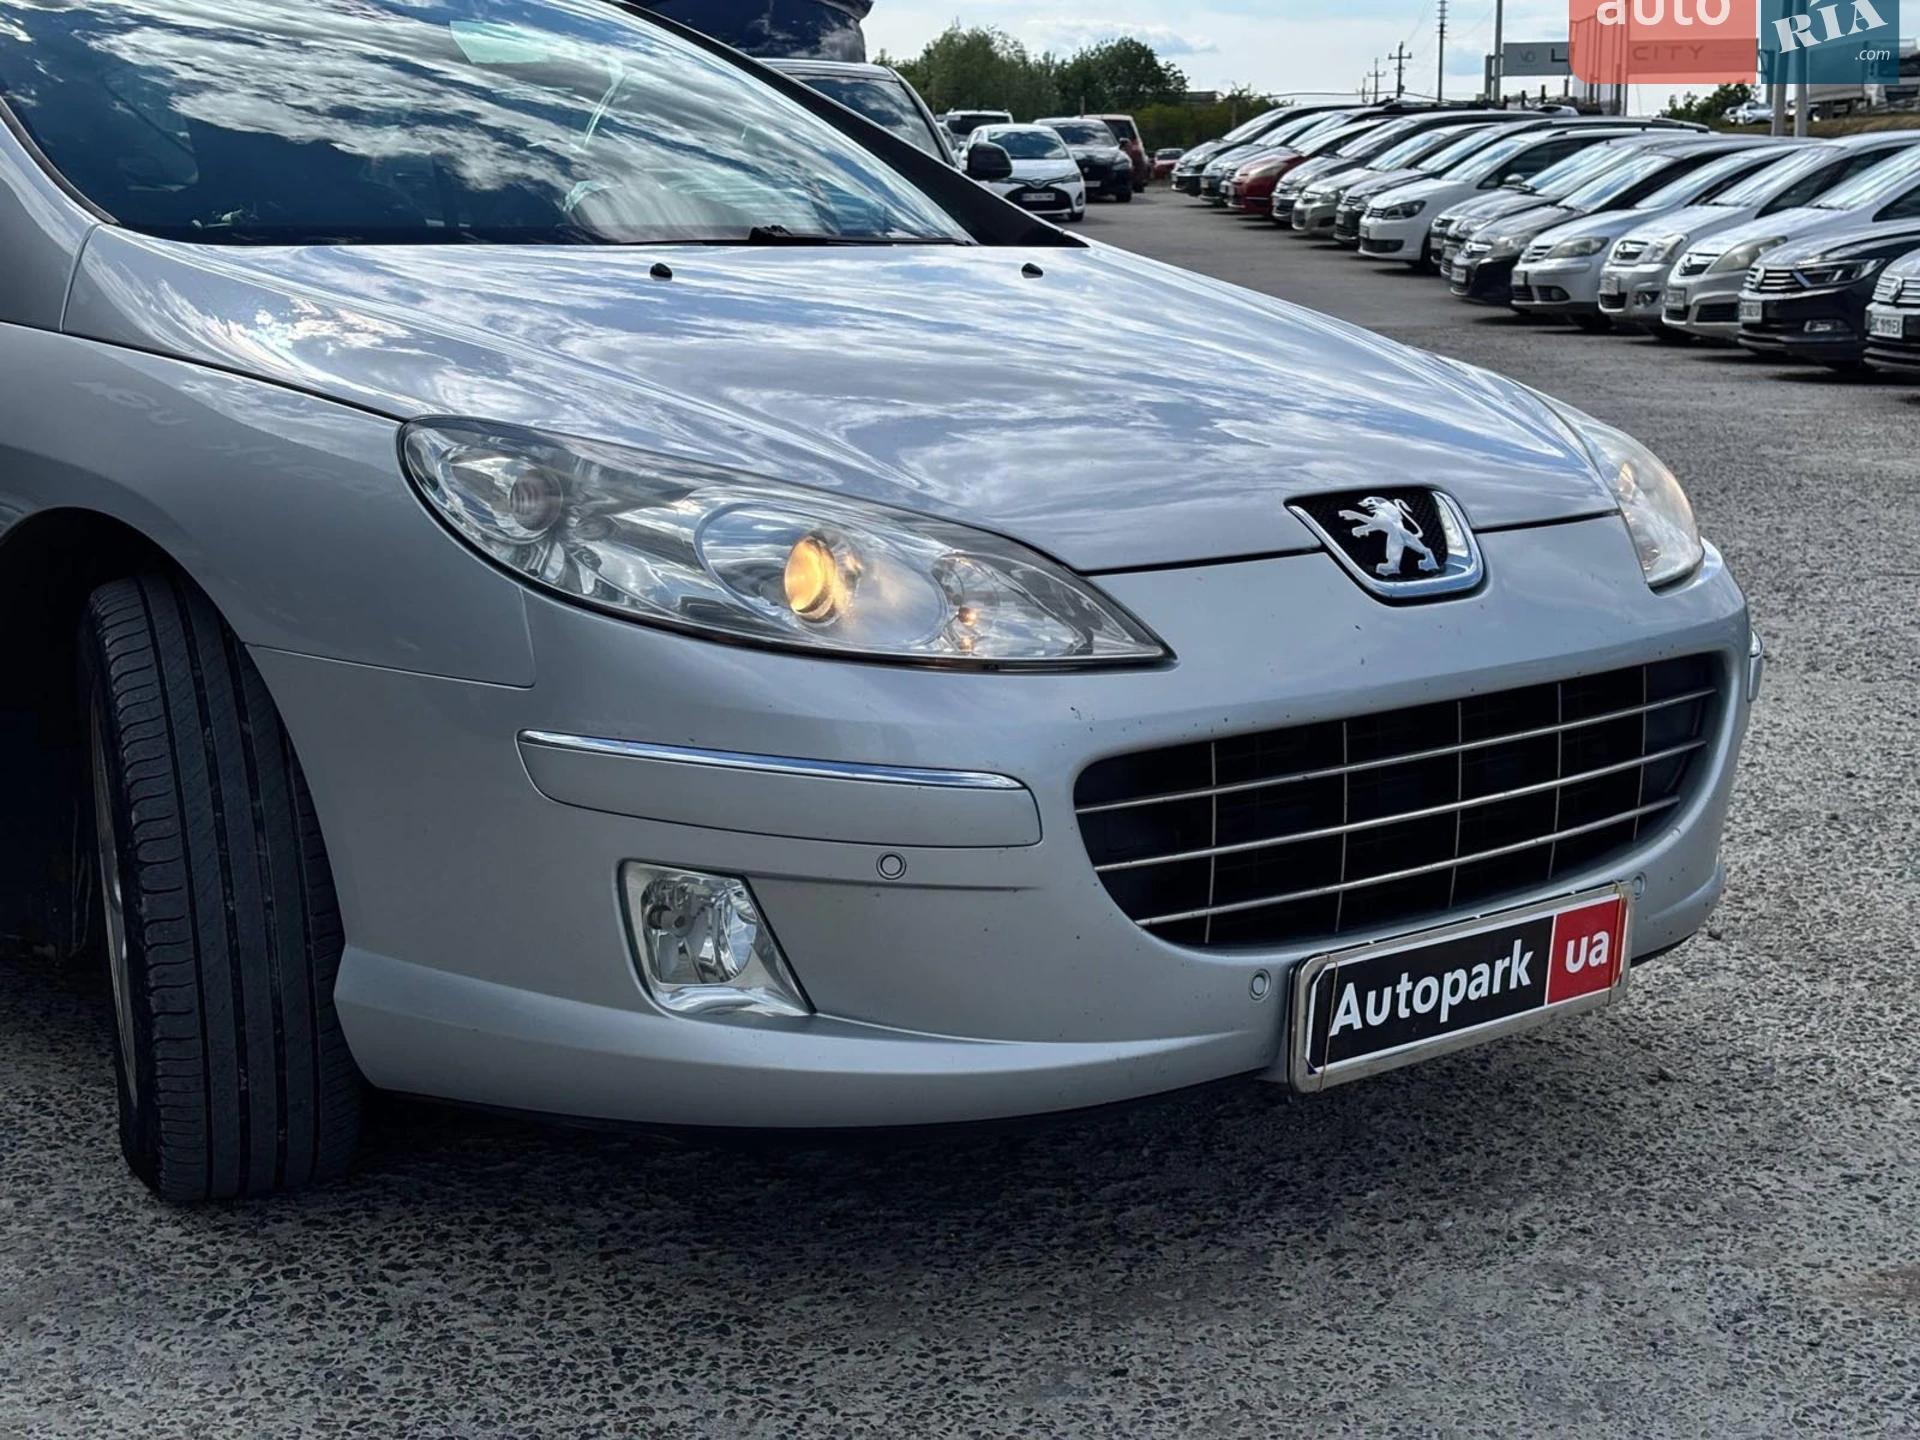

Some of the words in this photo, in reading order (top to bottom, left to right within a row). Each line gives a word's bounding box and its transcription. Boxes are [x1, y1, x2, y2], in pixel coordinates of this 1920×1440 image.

[1632, 45, 1705, 61] CITY
[1329, 938, 1534, 1037] Autopark
[1565, 931, 1610, 973] ua
